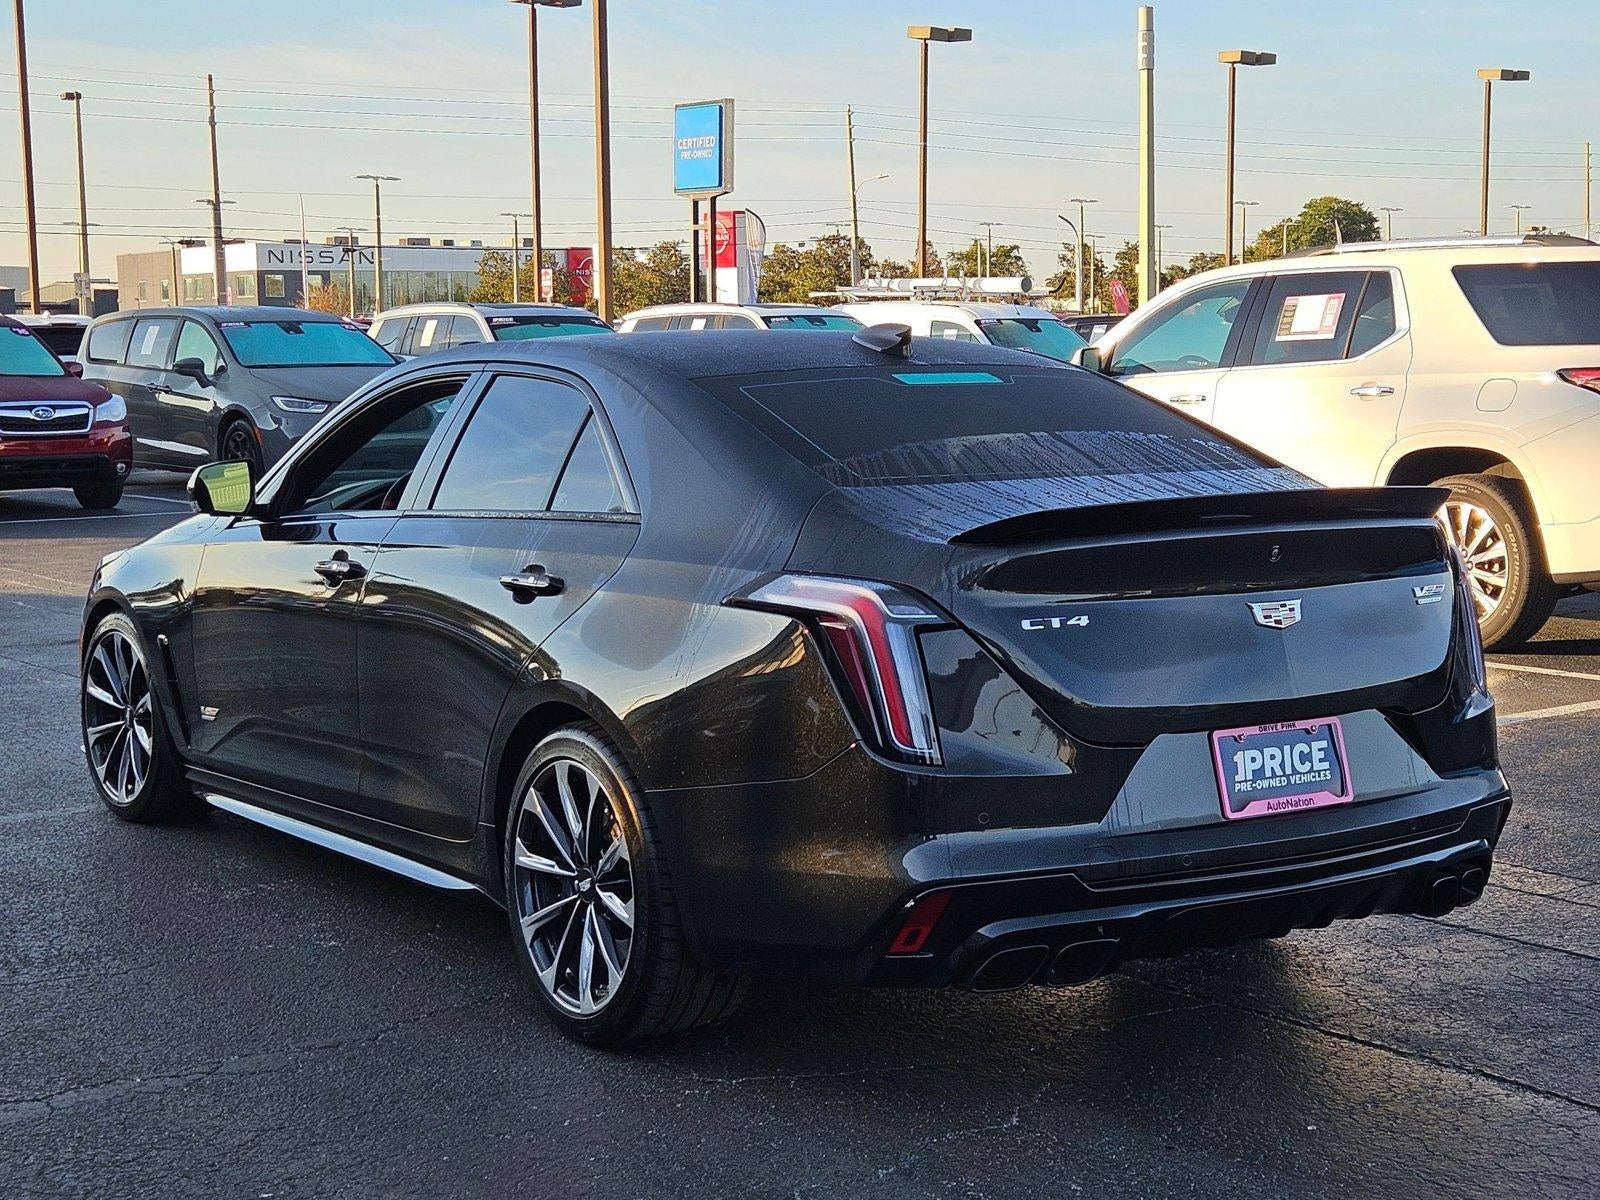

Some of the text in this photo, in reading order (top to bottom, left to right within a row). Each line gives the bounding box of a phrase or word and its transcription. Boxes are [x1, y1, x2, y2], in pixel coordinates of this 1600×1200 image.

[677, 135, 716, 150] CERTIFIED
[680, 149, 713, 160] PRE-OWNED
[267, 249, 375, 264] NISSAN
[1501, 523, 1520, 617] CONTINENTAL
[1021, 615, 1090, 630] CT4
[1258, 721, 1297, 733] DRIVE PINK
[1233, 740, 1331, 782] 1PRICE
[1234, 770, 1332, 793] PRE-OWNED VEHICLES
[1266, 796, 1315, 812] AutoNation
